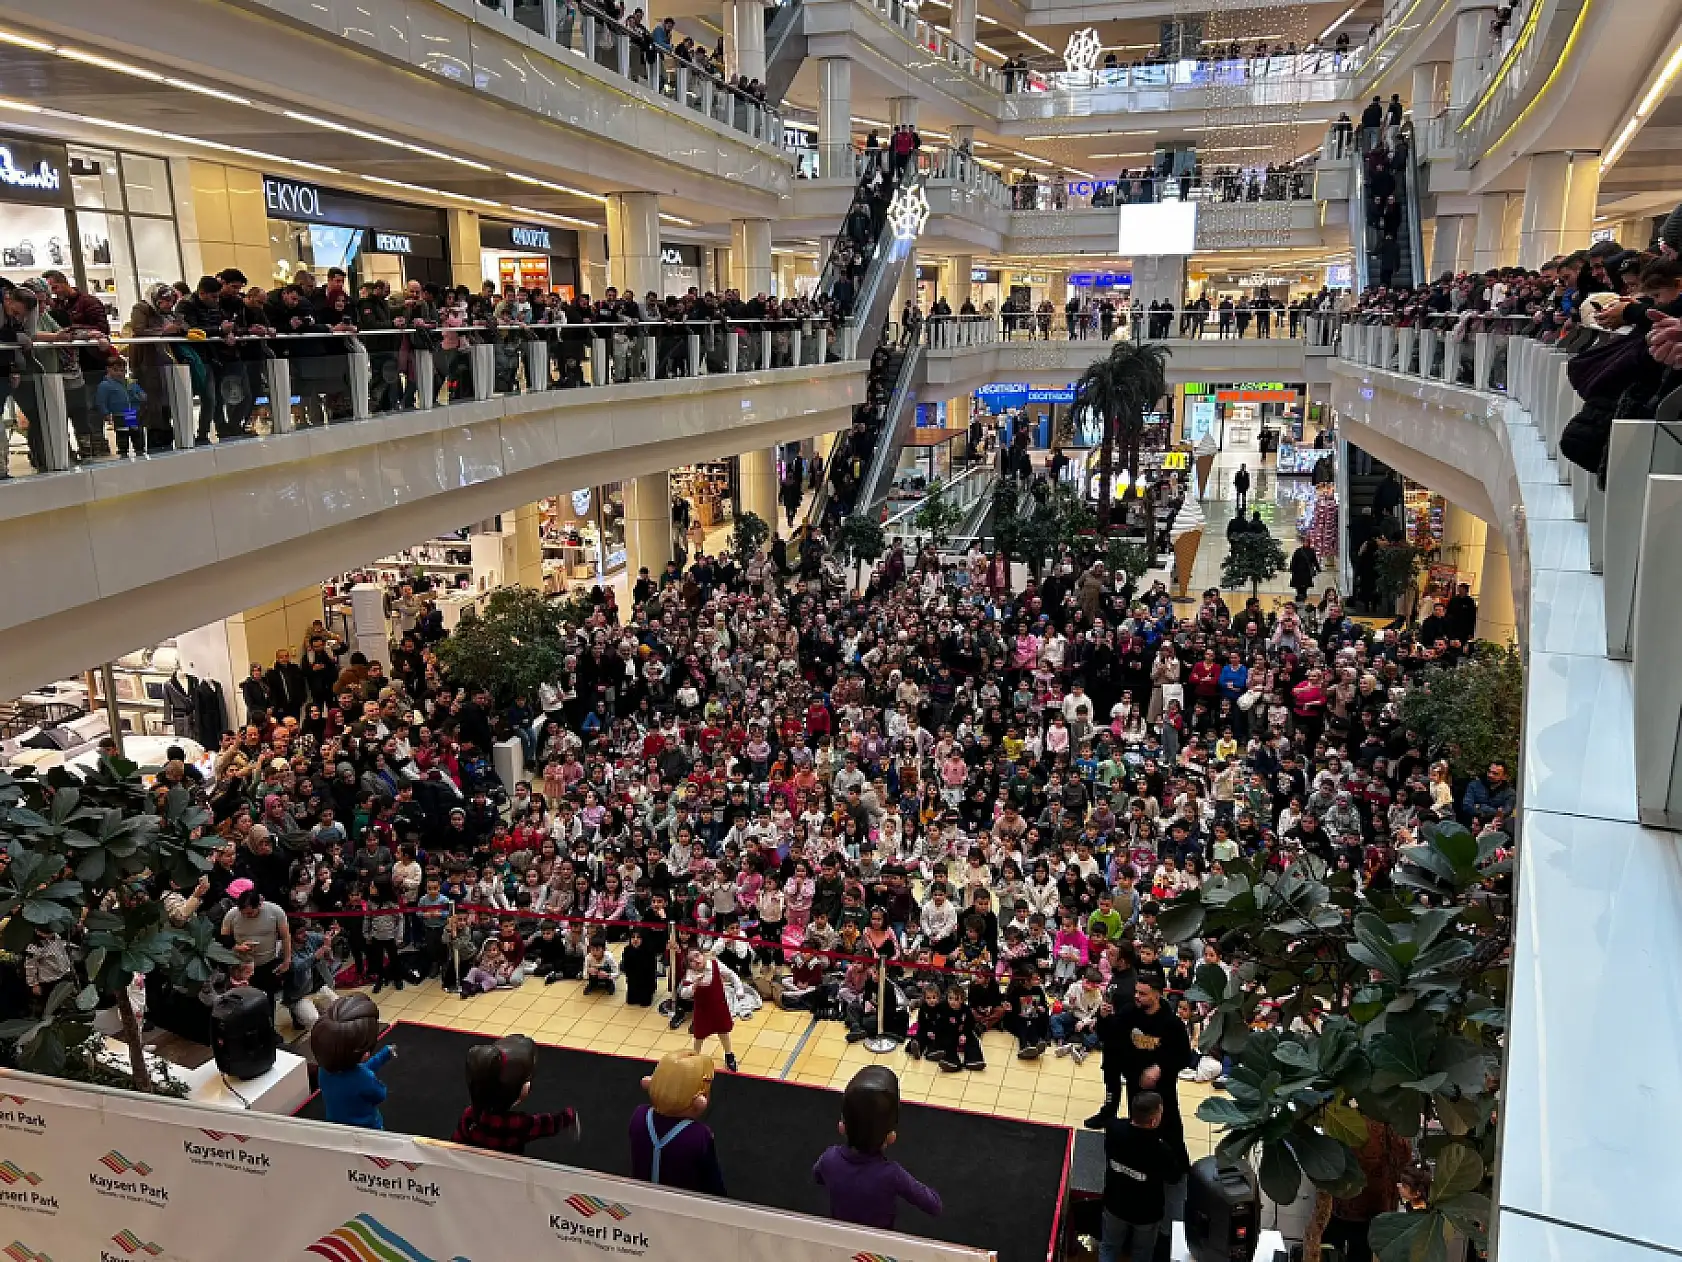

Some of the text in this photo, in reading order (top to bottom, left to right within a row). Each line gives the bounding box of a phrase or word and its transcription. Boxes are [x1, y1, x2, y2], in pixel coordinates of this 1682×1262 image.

[18, 1111, 46, 1128] Park
[184, 1140, 235, 1159] Kayseri
[238, 1149, 271, 1167] Park
[89, 1173, 137, 1193] Kayseri
[140, 1182, 169, 1200] Park
[347, 1168, 402, 1190] Kayseri
[407, 1178, 441, 1198] Park
[31, 1191, 60, 1209] Park
[549, 1213, 607, 1240] Kayseri
[612, 1226, 649, 1248] Park
